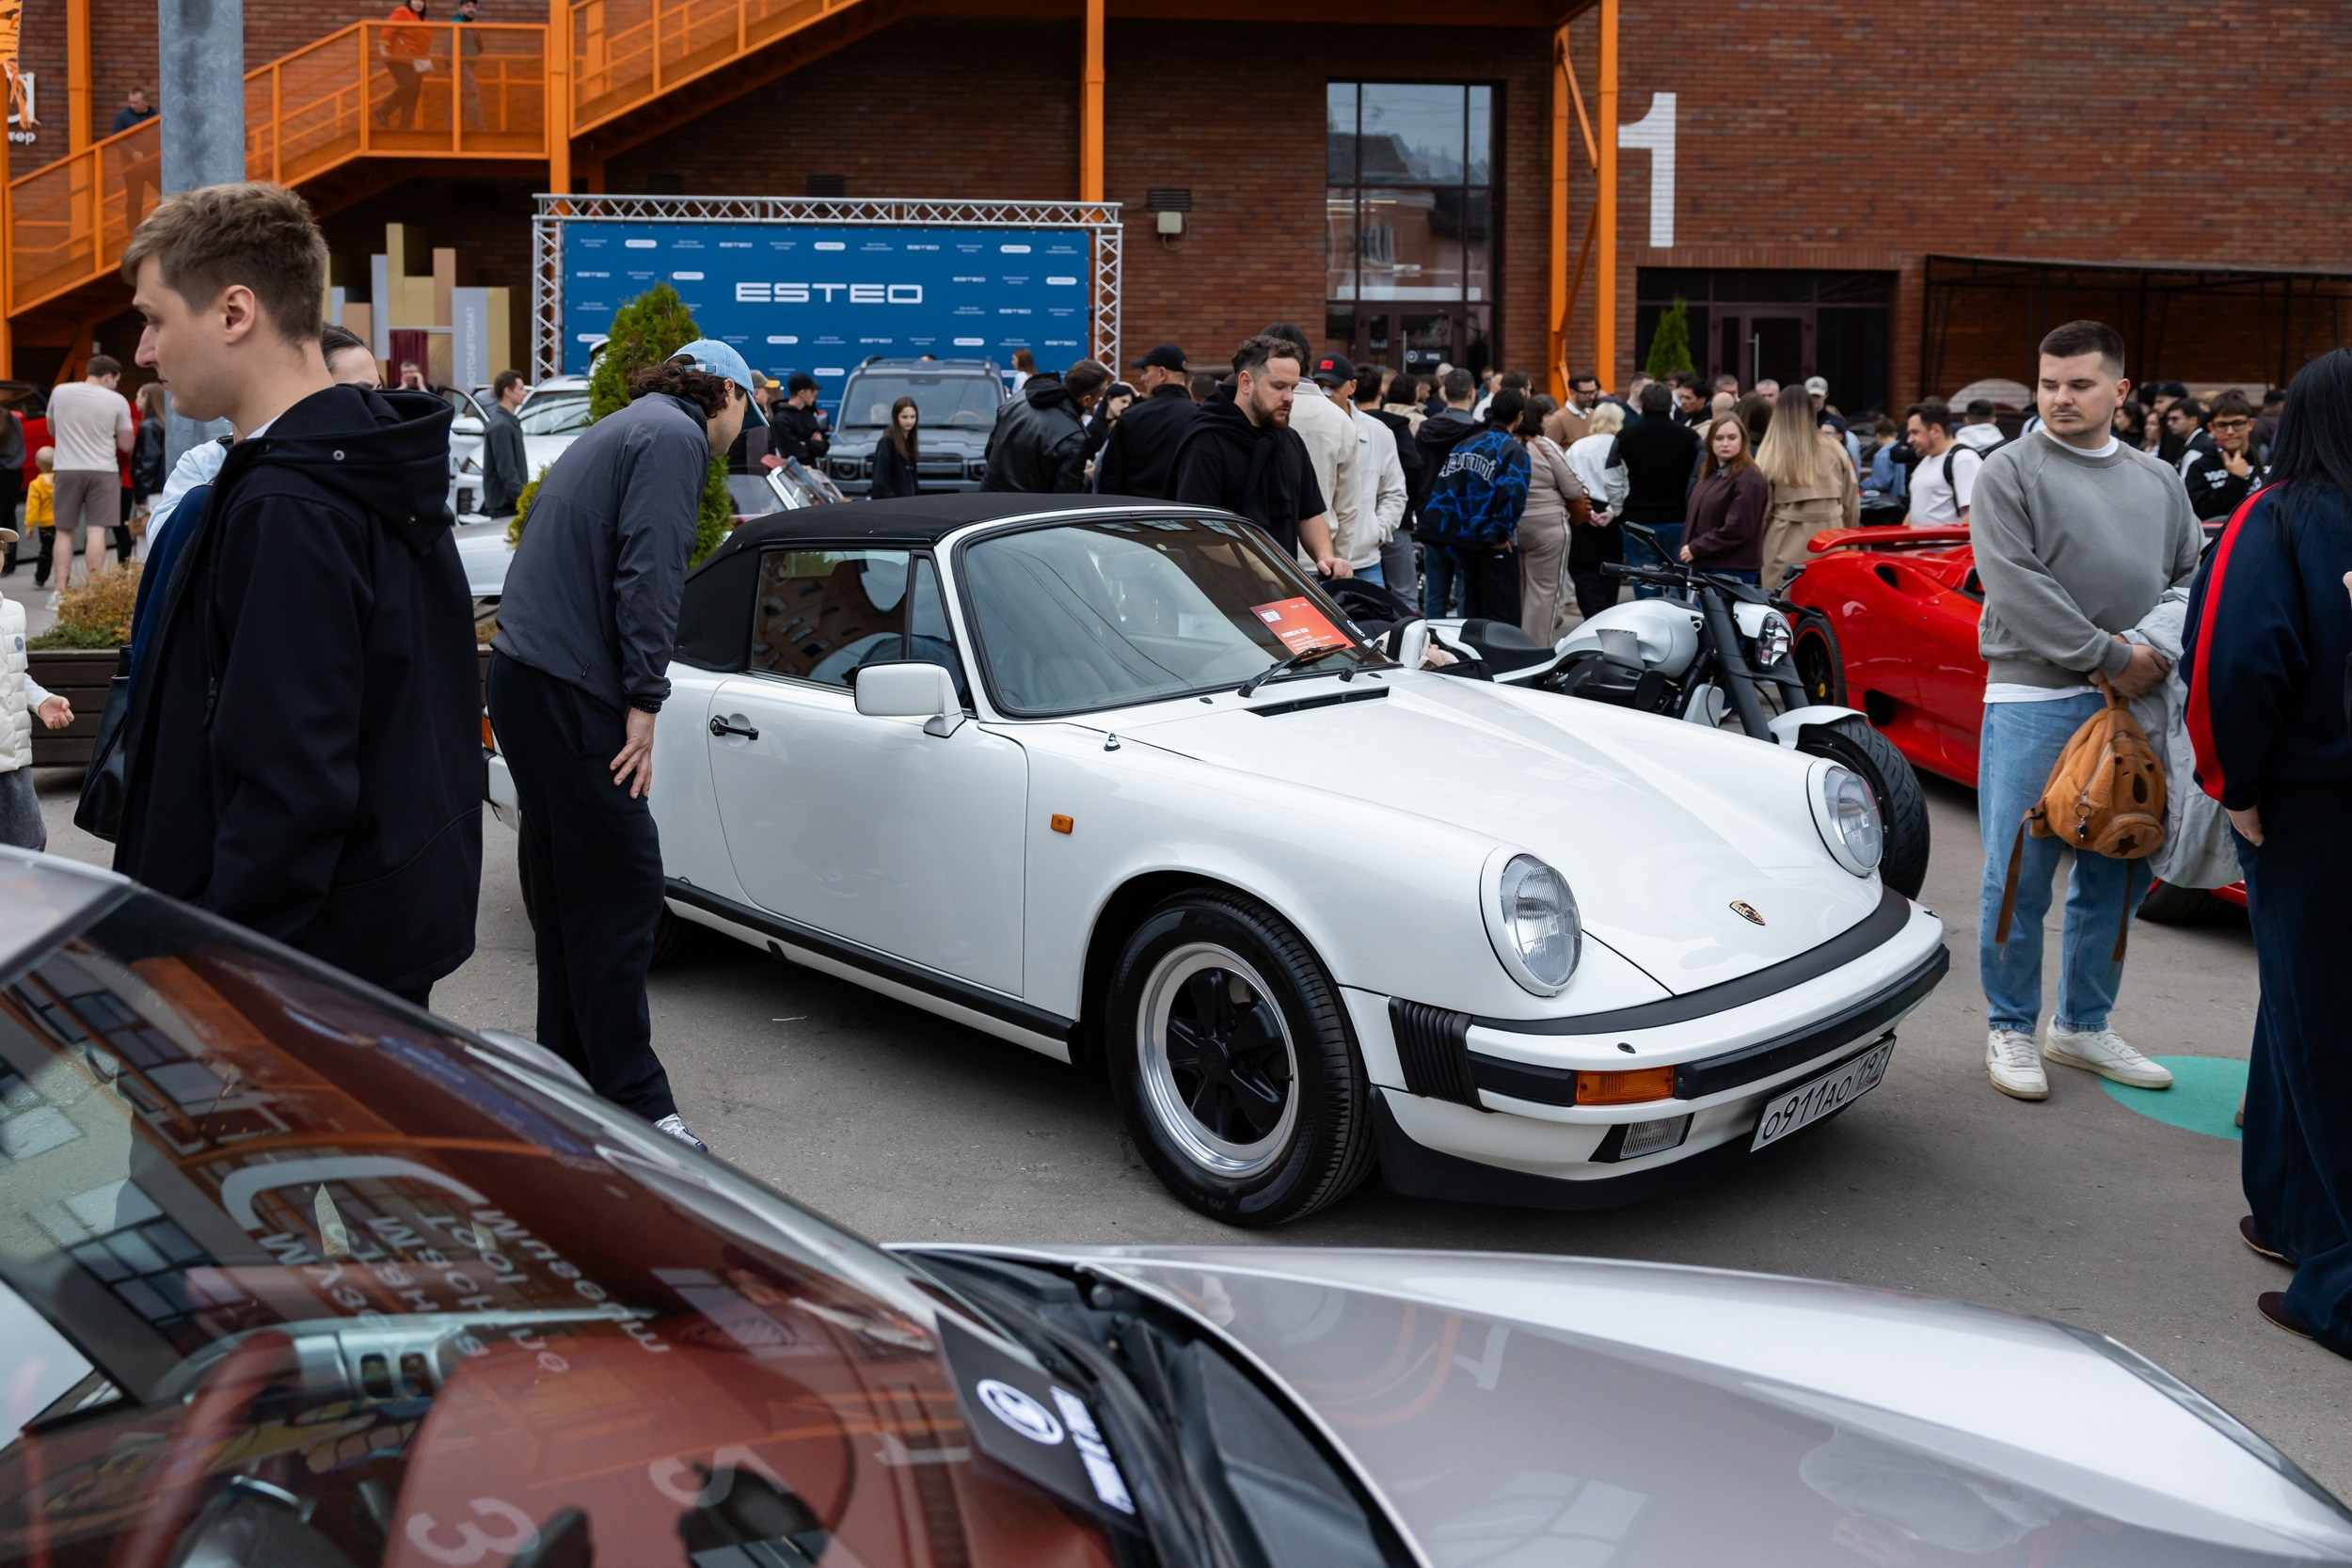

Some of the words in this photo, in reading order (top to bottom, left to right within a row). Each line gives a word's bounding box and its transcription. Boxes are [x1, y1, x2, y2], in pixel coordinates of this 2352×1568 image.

[1617, 92, 1677, 248] 1
[736, 281, 923, 305] ESTEO
[1859, 1045, 1888, 1083] 197
